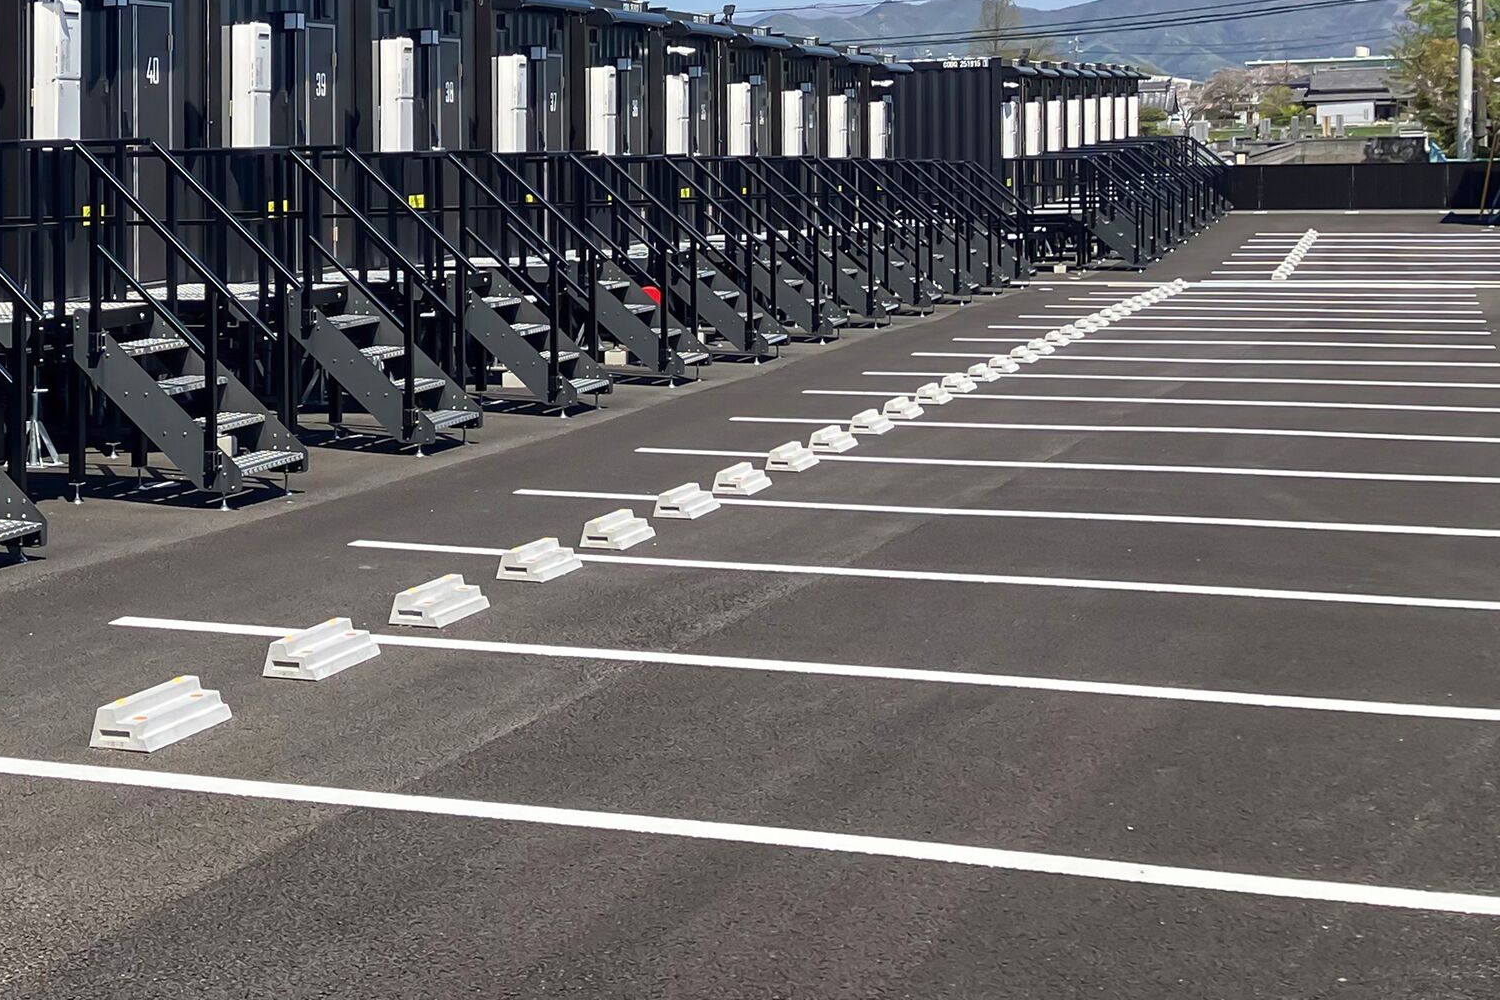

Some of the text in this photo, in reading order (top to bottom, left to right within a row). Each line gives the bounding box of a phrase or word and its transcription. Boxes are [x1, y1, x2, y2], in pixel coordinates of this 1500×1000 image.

[146, 56, 159, 85] 40
[315, 72, 326, 97] 39
[445, 81, 454, 103] 38
[550, 92, 557, 112] 37
